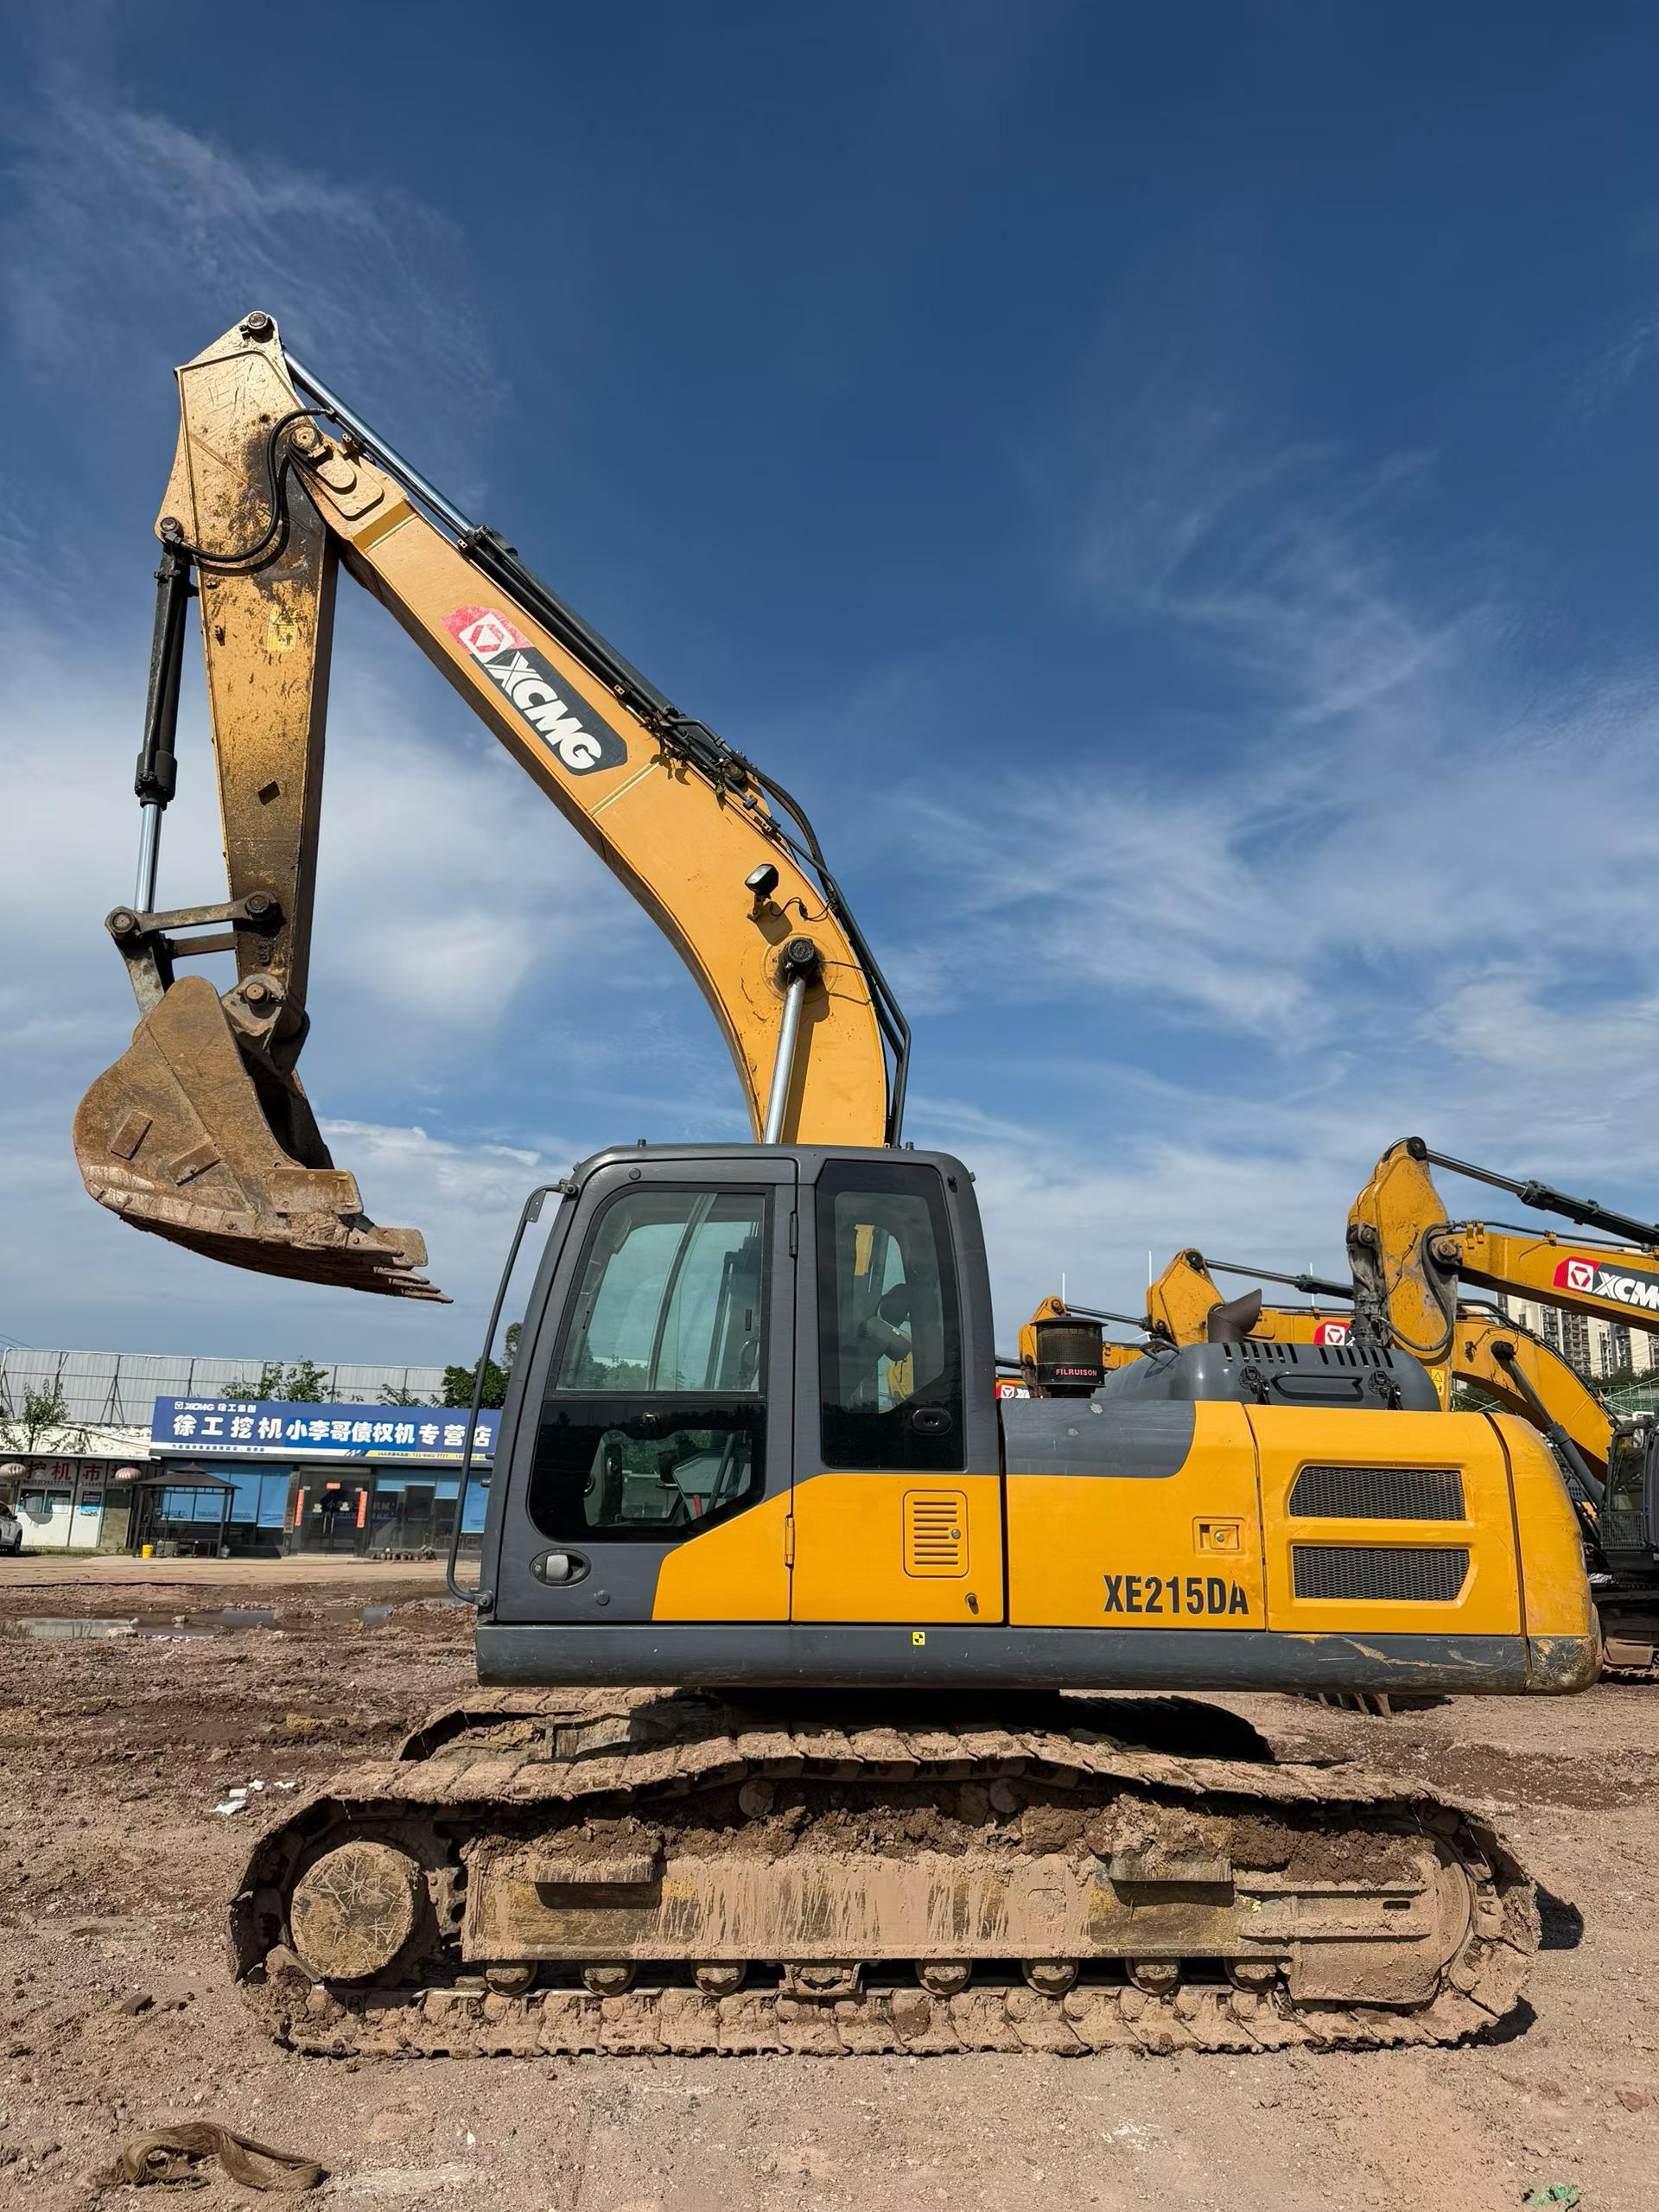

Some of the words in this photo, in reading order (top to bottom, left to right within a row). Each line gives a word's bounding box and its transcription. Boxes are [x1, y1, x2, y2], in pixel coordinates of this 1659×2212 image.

[484, 652, 602, 769] XCMG
[1592, 1271, 1659, 1309] XCM
[217, 1403, 257, 1413] 徐工集团
[1103, 1575, 1249, 1614] XE215DA
